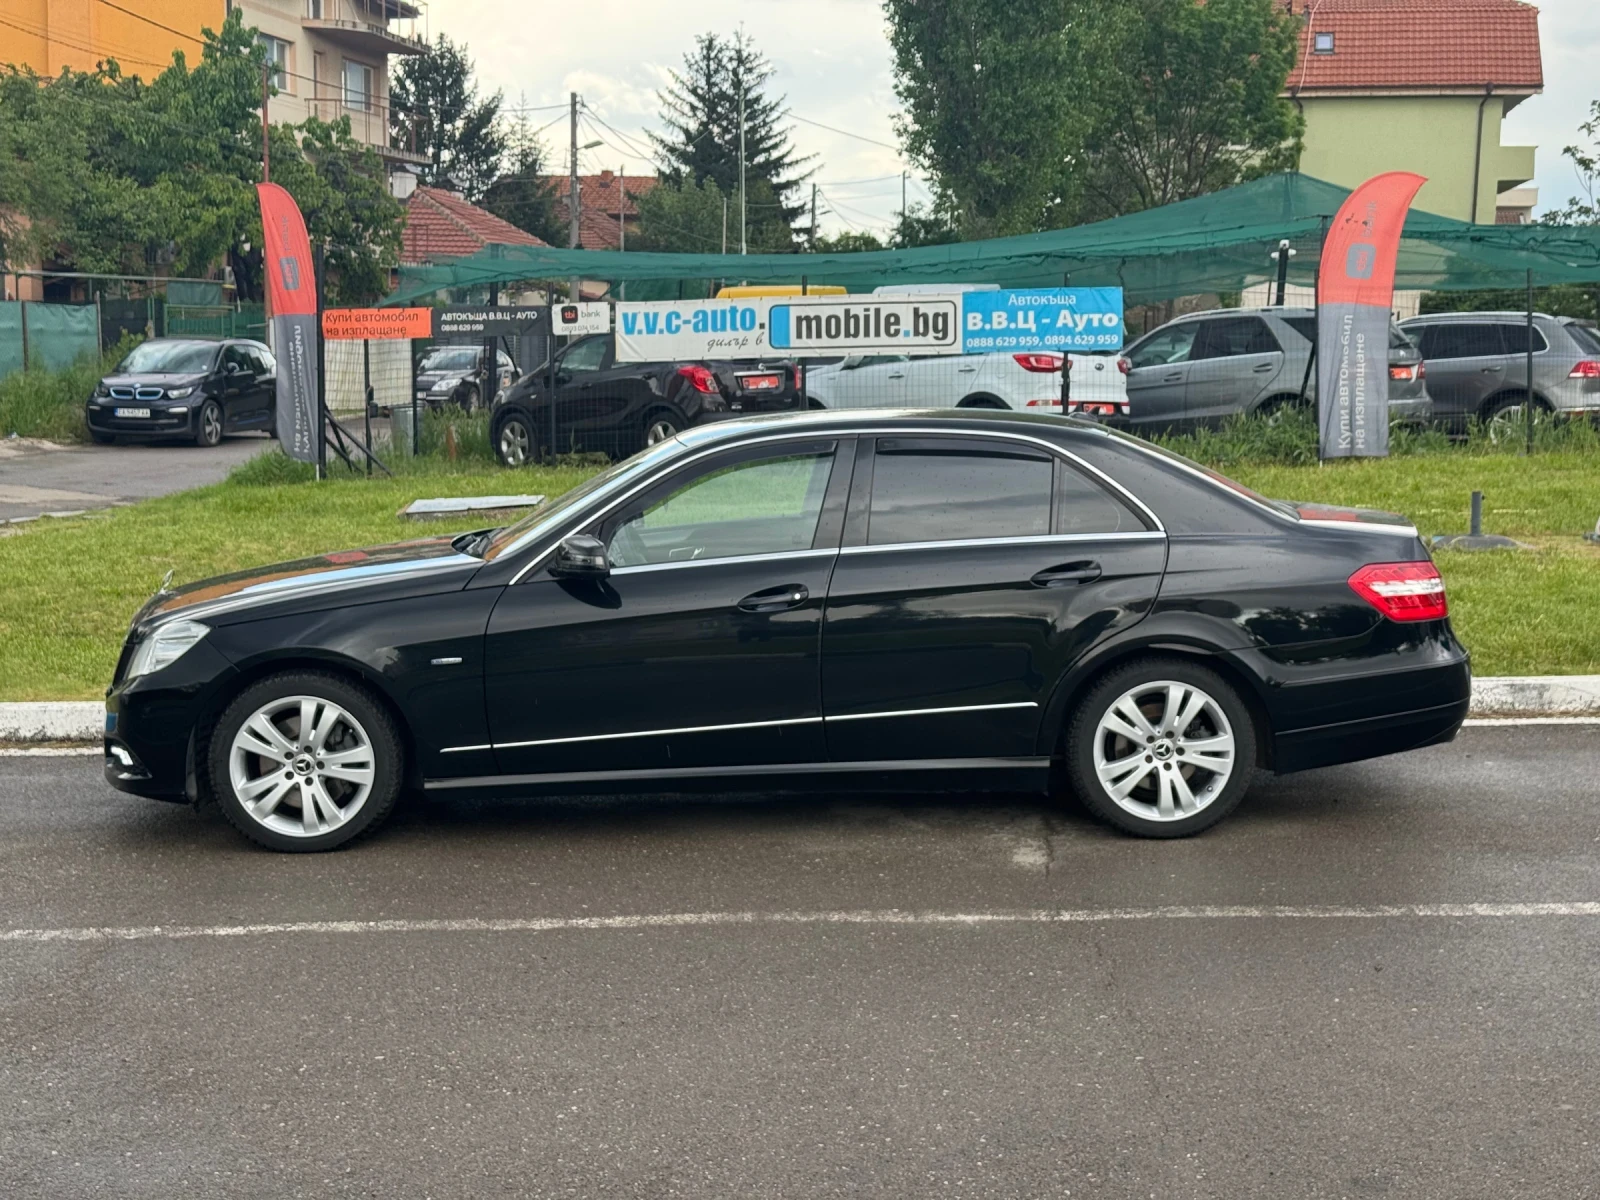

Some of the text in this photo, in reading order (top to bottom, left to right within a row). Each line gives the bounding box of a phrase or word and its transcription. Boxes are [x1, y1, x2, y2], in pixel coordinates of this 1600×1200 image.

[1008, 293, 1077, 306] Автокъща
[325, 311, 419, 324] Купи автомобил
[441, 312, 488, 321] АВТОКЪЩА
[516, 311, 538, 320] АУТО
[564, 310, 601, 319] tbi bank
[966, 310, 1037, 332] В.В.Ц
[1056, 309, 1119, 332] Ауто
[796, 306, 949, 341] mobile.bg
[326, 326, 407, 336] на изплащане
[966, 334, 1119, 348] 0888 629 959, 0894 629 959
[1338, 314, 1353, 449] Купи автомобил
[1355, 333, 1366, 449] на изплащане
